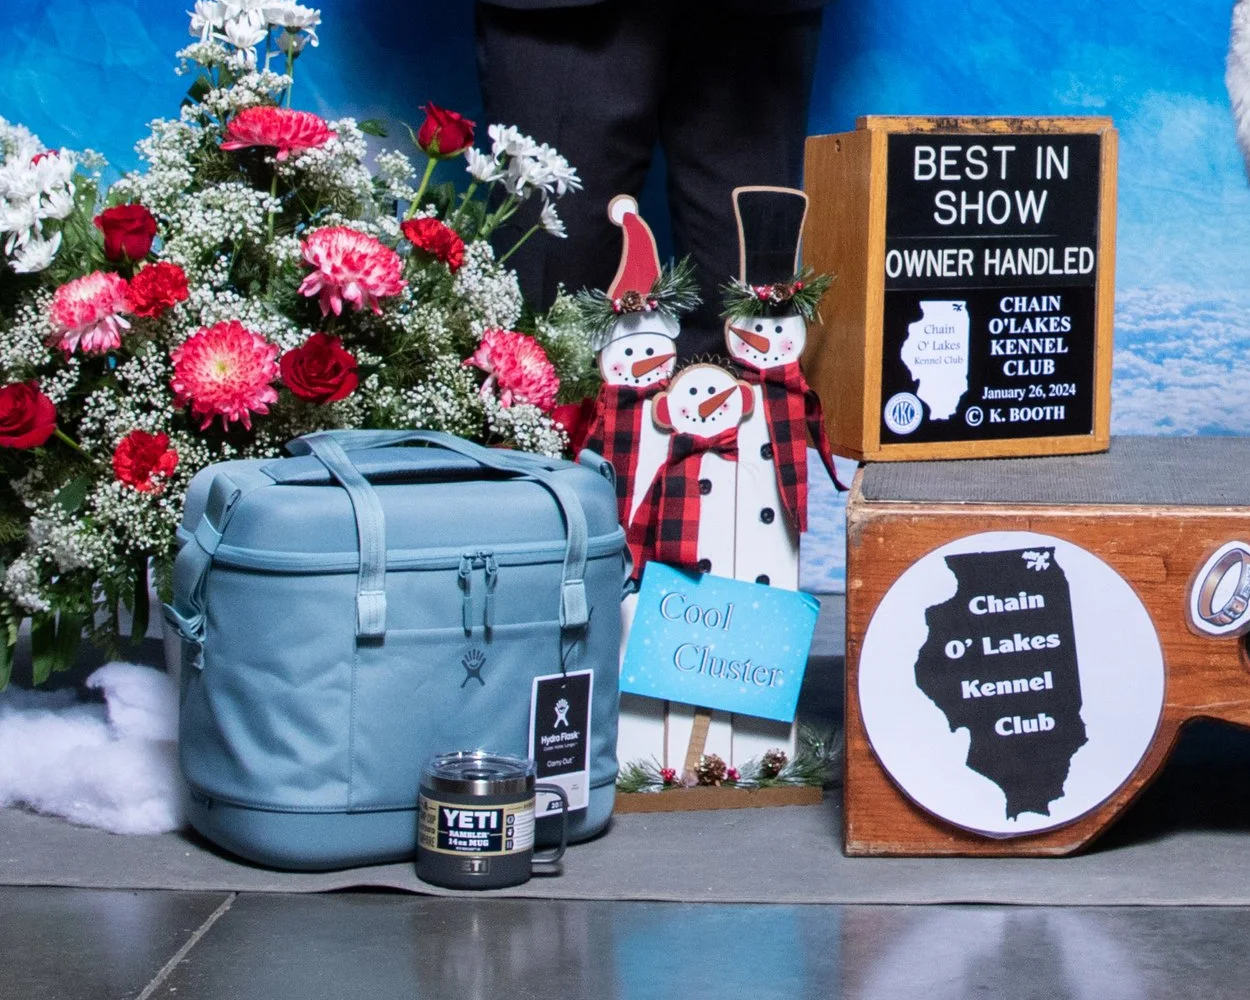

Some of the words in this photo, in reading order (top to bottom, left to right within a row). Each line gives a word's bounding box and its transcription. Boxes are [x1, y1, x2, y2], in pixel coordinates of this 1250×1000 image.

[914, 145, 1016, 181] BEST
[1036, 146, 1069, 180] IN
[933, 190, 1048, 225] SHOW
[886, 249, 974, 278] OWNER
[984, 246, 1095, 276] HANDLED
[999, 295, 1062, 313] CHAIN
[923, 323, 955, 335] Chain
[988, 315, 1072, 335] O'LAKES
[917, 341, 930, 352] O'
[932, 338, 961, 352] Lakes
[990, 337, 1069, 356] KENNEL
[914, 354, 942, 366] Kennel
[943, 354, 964, 365] Club
[1003, 358, 1055, 377] CLUB
[982, 387, 1025, 401] January
[1028, 385, 1046, 399] 26,
[1048, 383, 1076, 397] 2024
[892, 401, 915, 426] AKC
[989, 408, 1006, 423] K.
[1009, 405, 1065, 422] BOOTH
[659, 591, 734, 632] Cool
[968, 591, 1045, 616] Chain
[944, 638, 973, 659] O’
[981, 632, 1061, 656] Lakes
[673, 642, 784, 688] Cluster
[960, 670, 1054, 699] Kennel
[994, 712, 1056, 736] Club
[541, 734, 560, 746] Hydro
[560, 731, 578, 741] Flask
[443, 808, 498, 829] YETI
[448, 830, 488, 839] RAMBLER
[448, 838, 467, 847] 14oz
[468, 839, 489, 847] MUG
